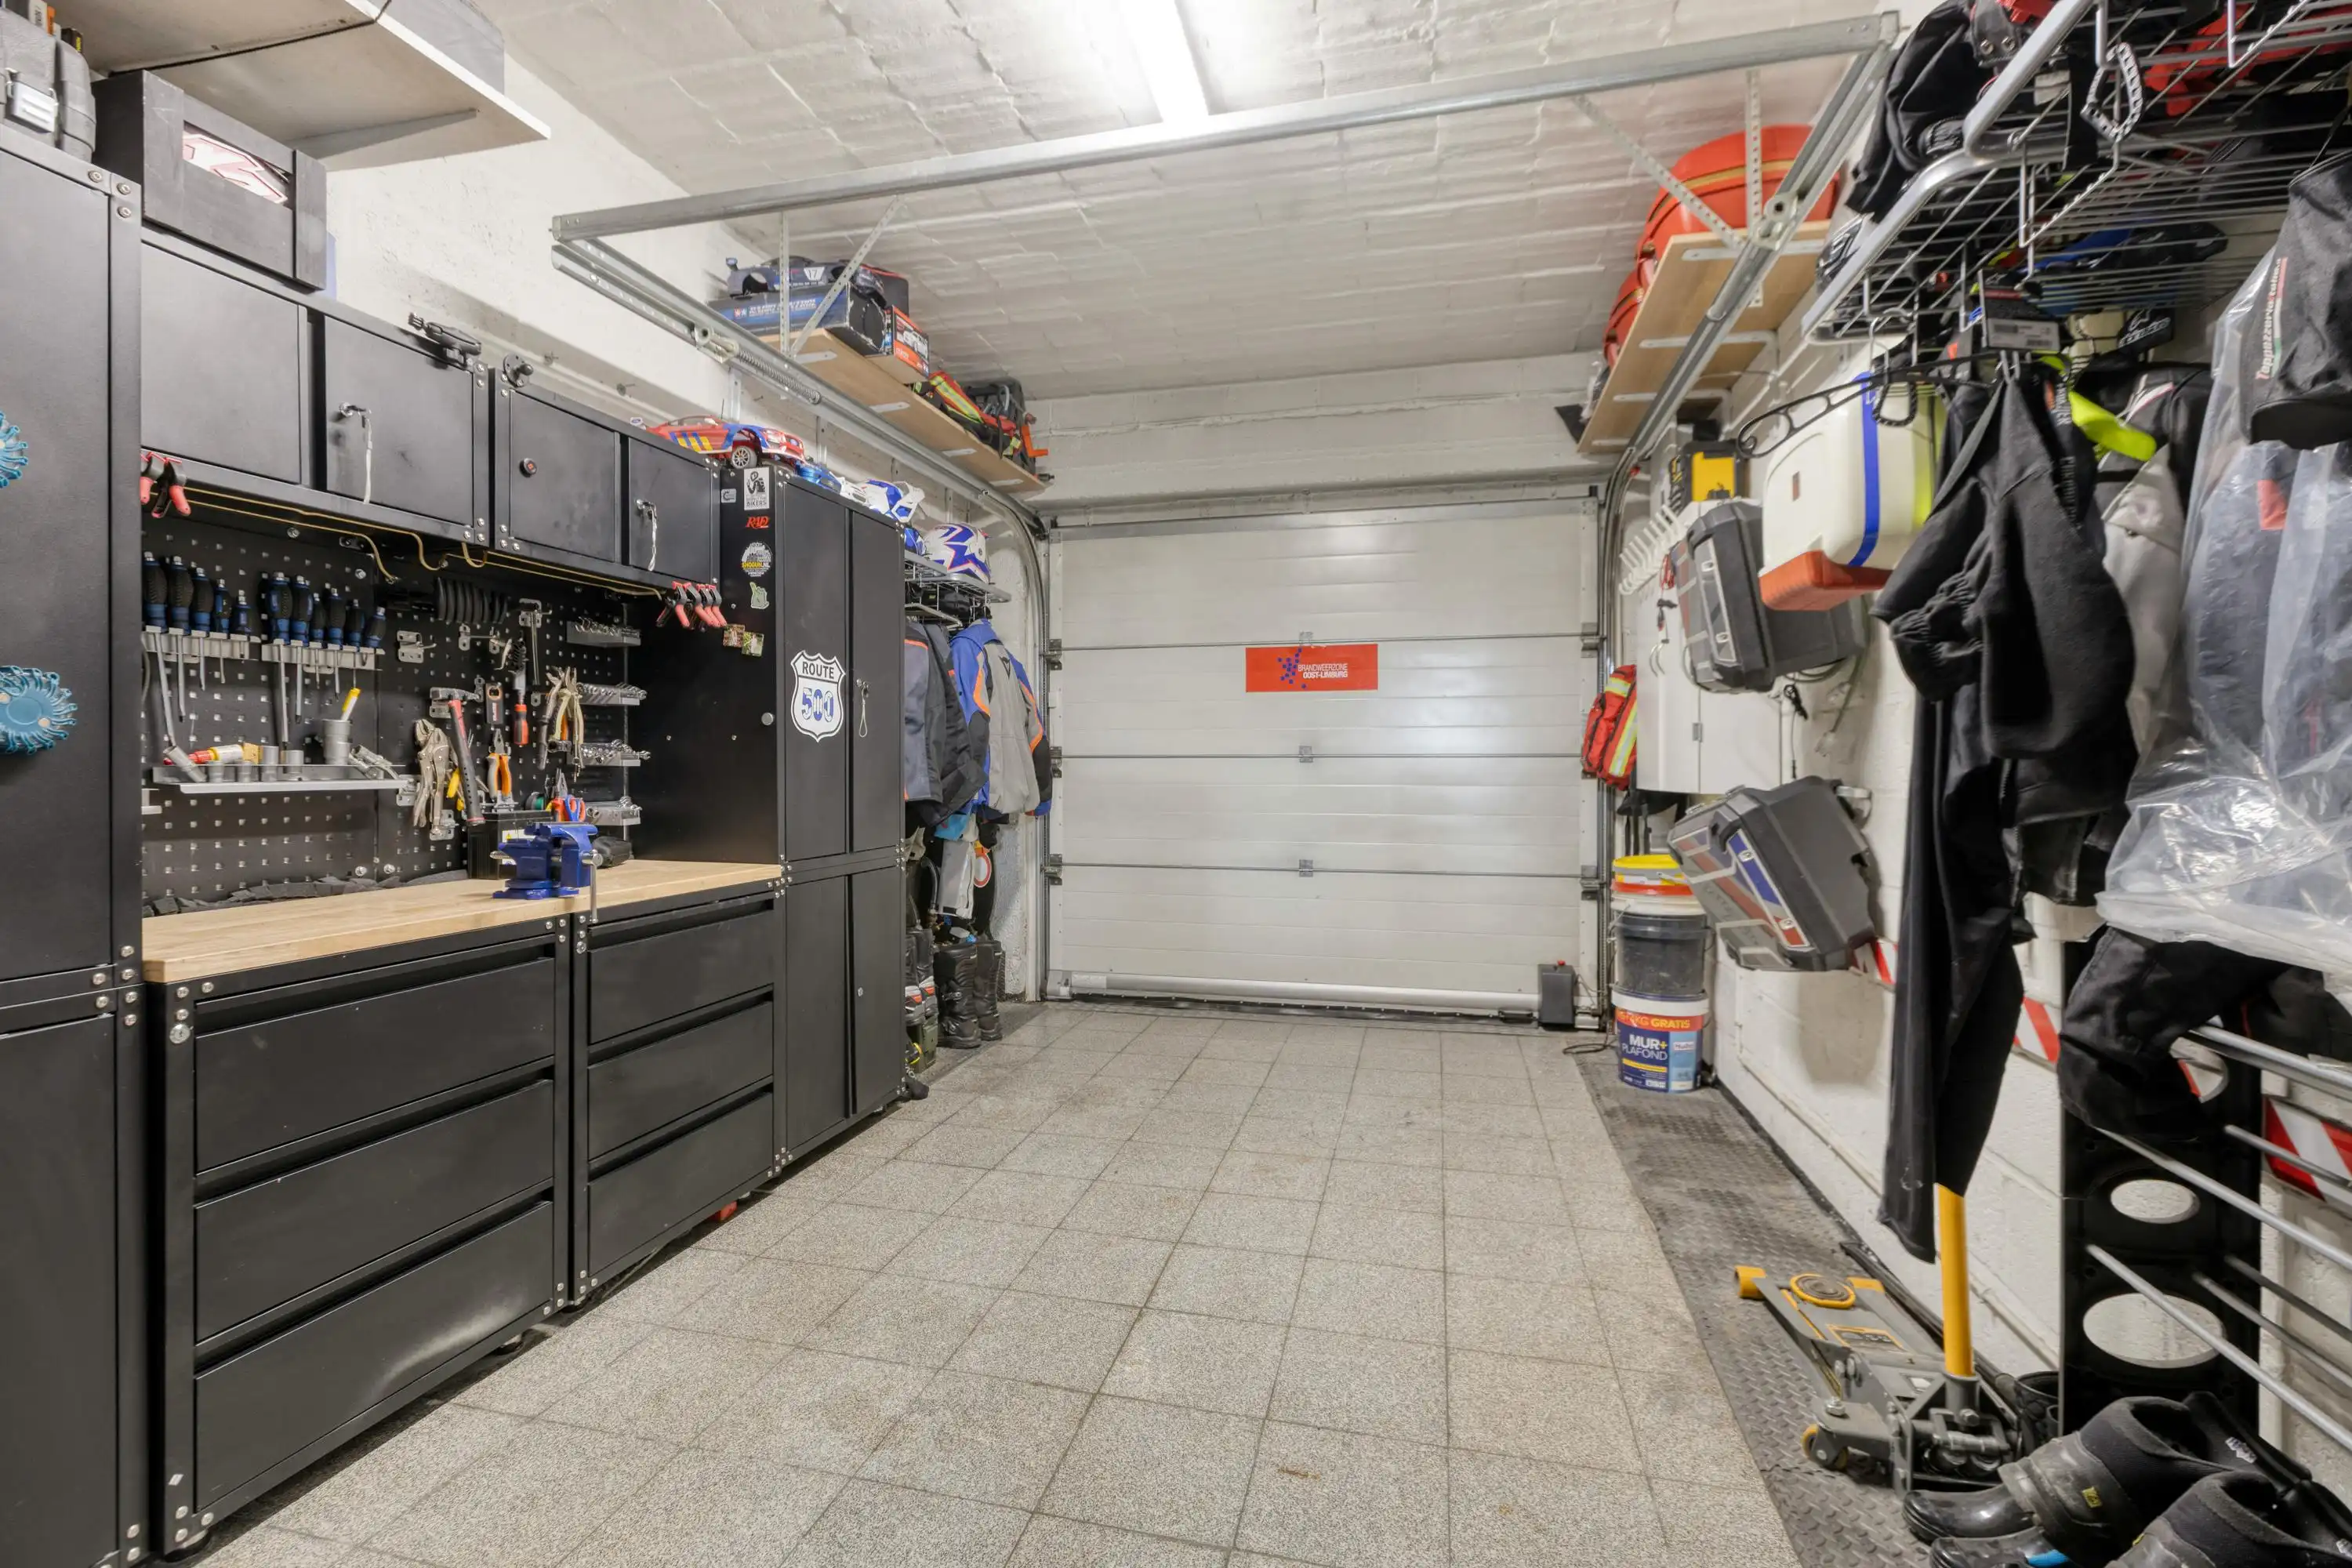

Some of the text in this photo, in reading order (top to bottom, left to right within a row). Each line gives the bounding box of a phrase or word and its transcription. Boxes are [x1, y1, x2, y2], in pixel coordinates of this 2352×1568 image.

[802, 661, 835, 680] ROUTE
[801, 687, 834, 723] 500
[1650, 1018, 1691, 1029] GRATIS
[1629, 1033, 1668, 1051] MUR+
[1621, 1043, 1668, 1061] PLAFOND
